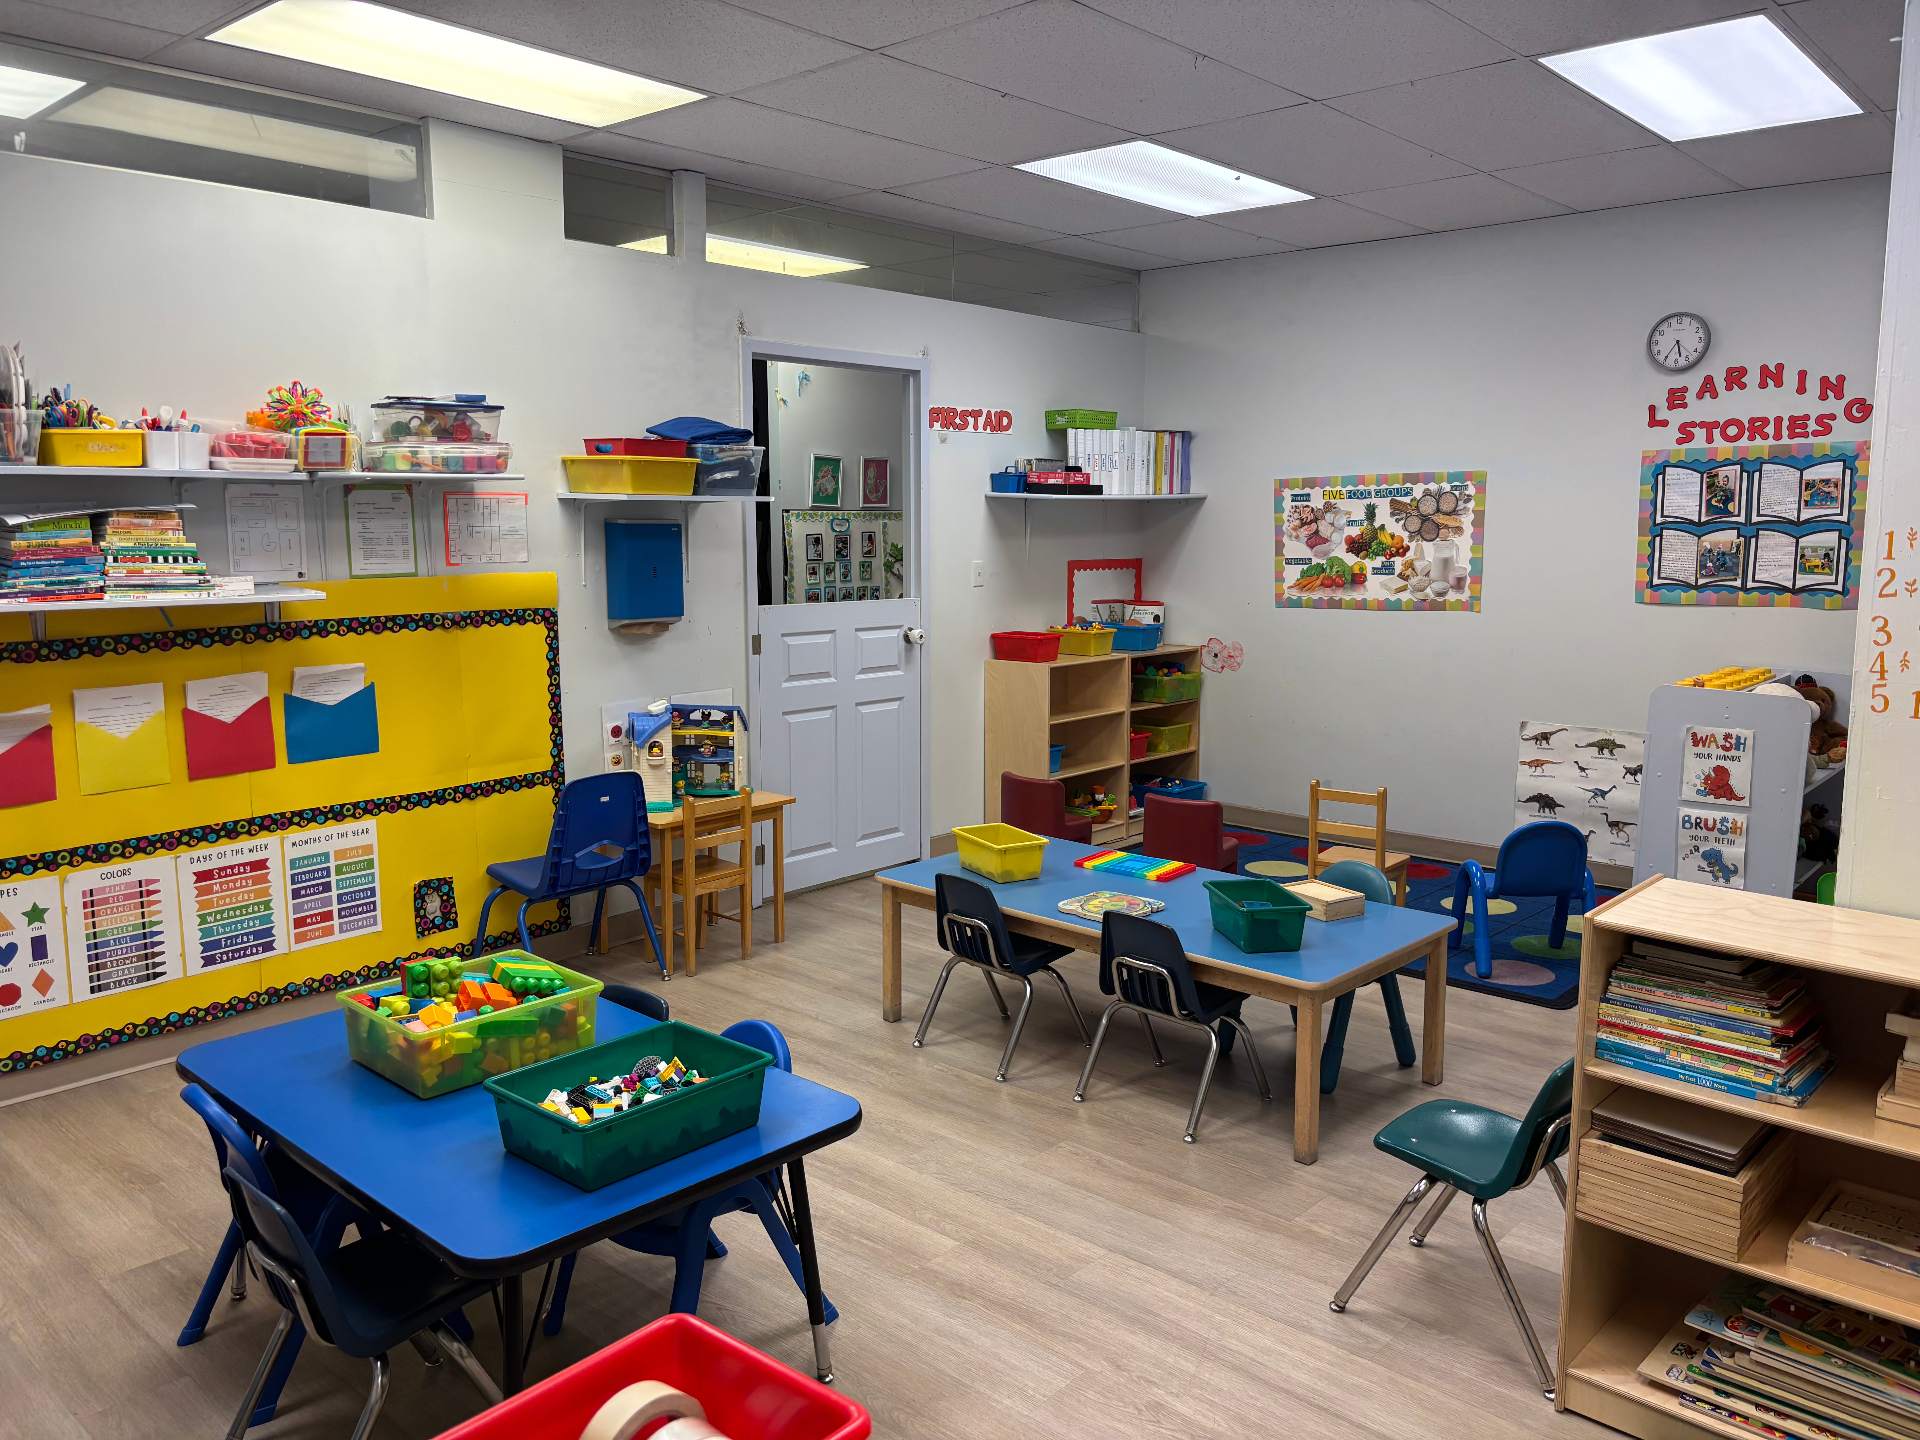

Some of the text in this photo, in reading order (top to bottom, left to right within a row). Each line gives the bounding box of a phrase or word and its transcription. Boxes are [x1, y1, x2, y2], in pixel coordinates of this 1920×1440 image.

[1694, 326, 1700, 334] 2
[1698, 336, 1702, 344] 3
[1684, 354, 1690, 362] 5
[1648, 363, 1873, 428] LEARNING
[929, 407, 1012, 432] FIRST AID
[1676, 413, 1836, 445] STORIES
[1323, 487, 1413, 500] FIVE FOOD GROUPS
[52, 521, 83, 530] Munch!
[26, 540, 60, 548] JUNGLE
[1882, 530, 1896, 560] 1
[1876, 568, 1898, 598] 2
[1871, 616, 1892, 646] 3
[1868, 651, 1888, 681] 4
[1870, 684, 1890, 713] 5
[1691, 732, 1748, 752] WASH
[1694, 752, 1742, 762] YOUR HANDS
[1682, 814, 1744, 836] BRUSH
[292, 828, 370, 848] MONTHS OF THE YEAR
[1688, 835, 1736, 846] YOUR TEETH
[190, 843, 269, 864] DAYS OF THE WEEK
[347, 848, 362, 857] JULY
[295, 856, 325, 867] JANUARY
[343, 862, 368, 872] AUGUST
[100, 868, 132, 880] COLORS
[213, 865, 251, 878] Sunday
[295, 870, 327, 882] FEBRUARY
[213, 879, 252, 893] Monday
[339, 876, 372, 888] SEPTEMBER
[106, 885, 126, 893] PINK
[301, 885, 322, 895] MARCH
[213, 892, 255, 907] Tuesday
[343, 890, 370, 901] OCTOBER
[100, 905, 135, 916] ORANGE
[304, 900, 322, 910] APRIL
[342, 904, 374, 916] NOVEMBER
[207, 904, 265, 923] Wednesday
[307, 915, 321, 924] MAY
[102, 915, 135, 926] YELLOW
[343, 918, 374, 930] DECEMBER
[107, 925, 133, 936] GREEN
[213, 919, 260, 935] Thursday
[307, 929, 323, 939] JUNE
[110, 937, 131, 946] BLUE
[222, 934, 254, 948] Friday
[106, 946, 136, 957] PURPLE
[216, 945, 263, 962] Saturday
[28, 959, 55, 968] RECTANGLE
[107, 957, 137, 968] BROWN
[112, 968, 135, 978] GRAY
[110, 977, 138, 989] BLACK
